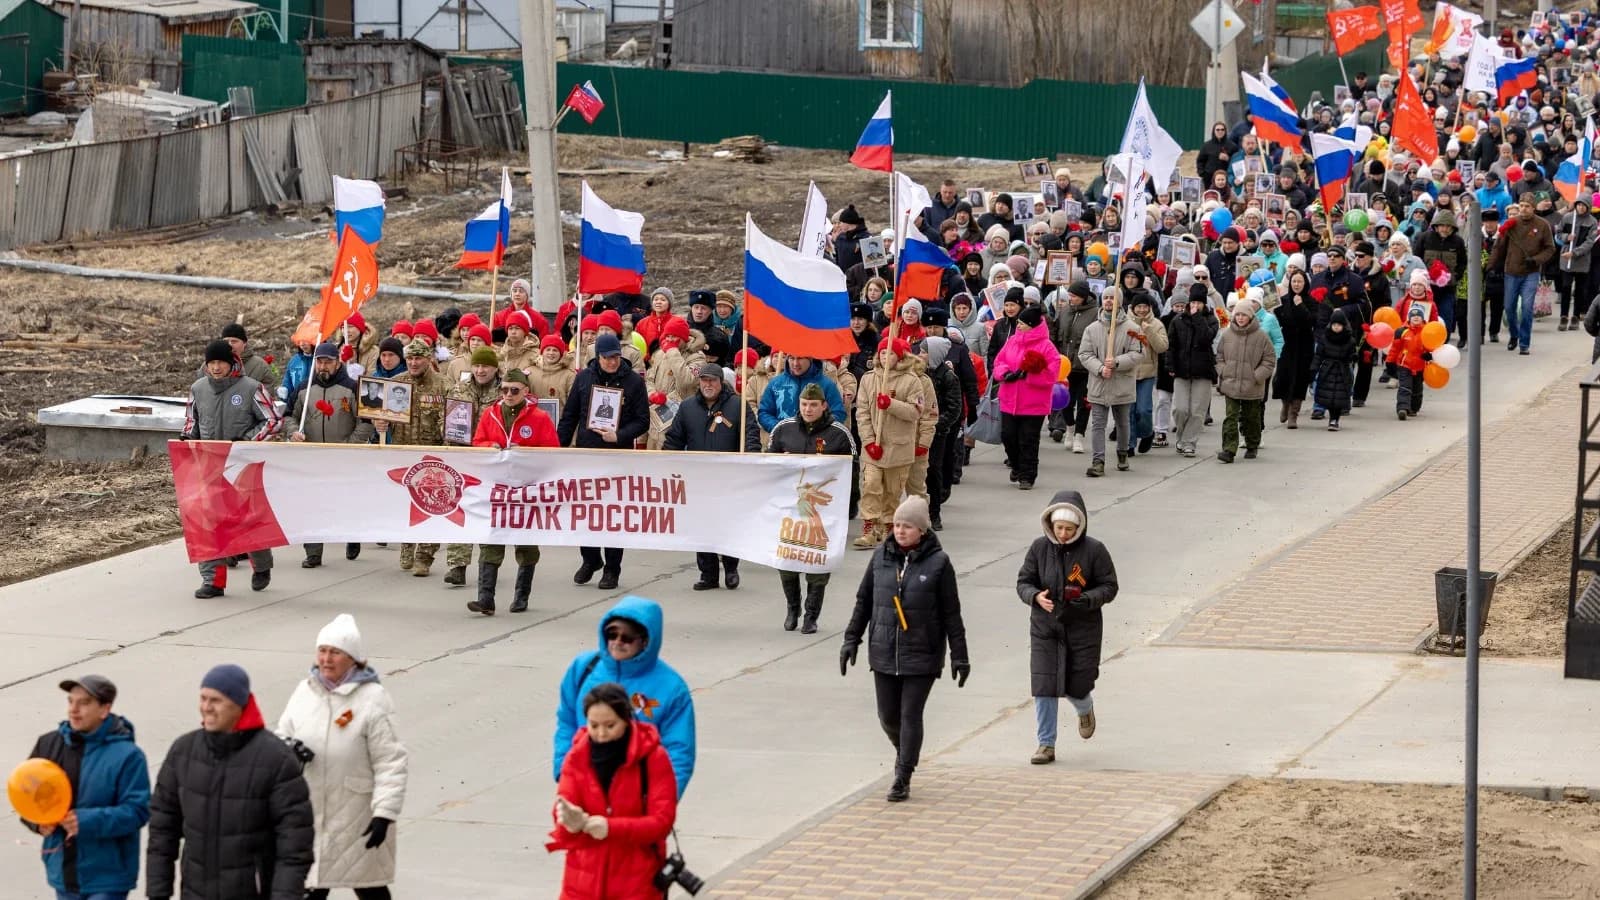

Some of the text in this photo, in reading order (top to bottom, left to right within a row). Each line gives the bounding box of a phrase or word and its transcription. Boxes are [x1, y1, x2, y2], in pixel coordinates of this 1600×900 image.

[489, 474, 687, 505] БЕССМЕРТНЫЙ
[490, 503, 675, 534] ПОЛК РОССИИ
[777, 545, 827, 565] ПОБЕДА!
